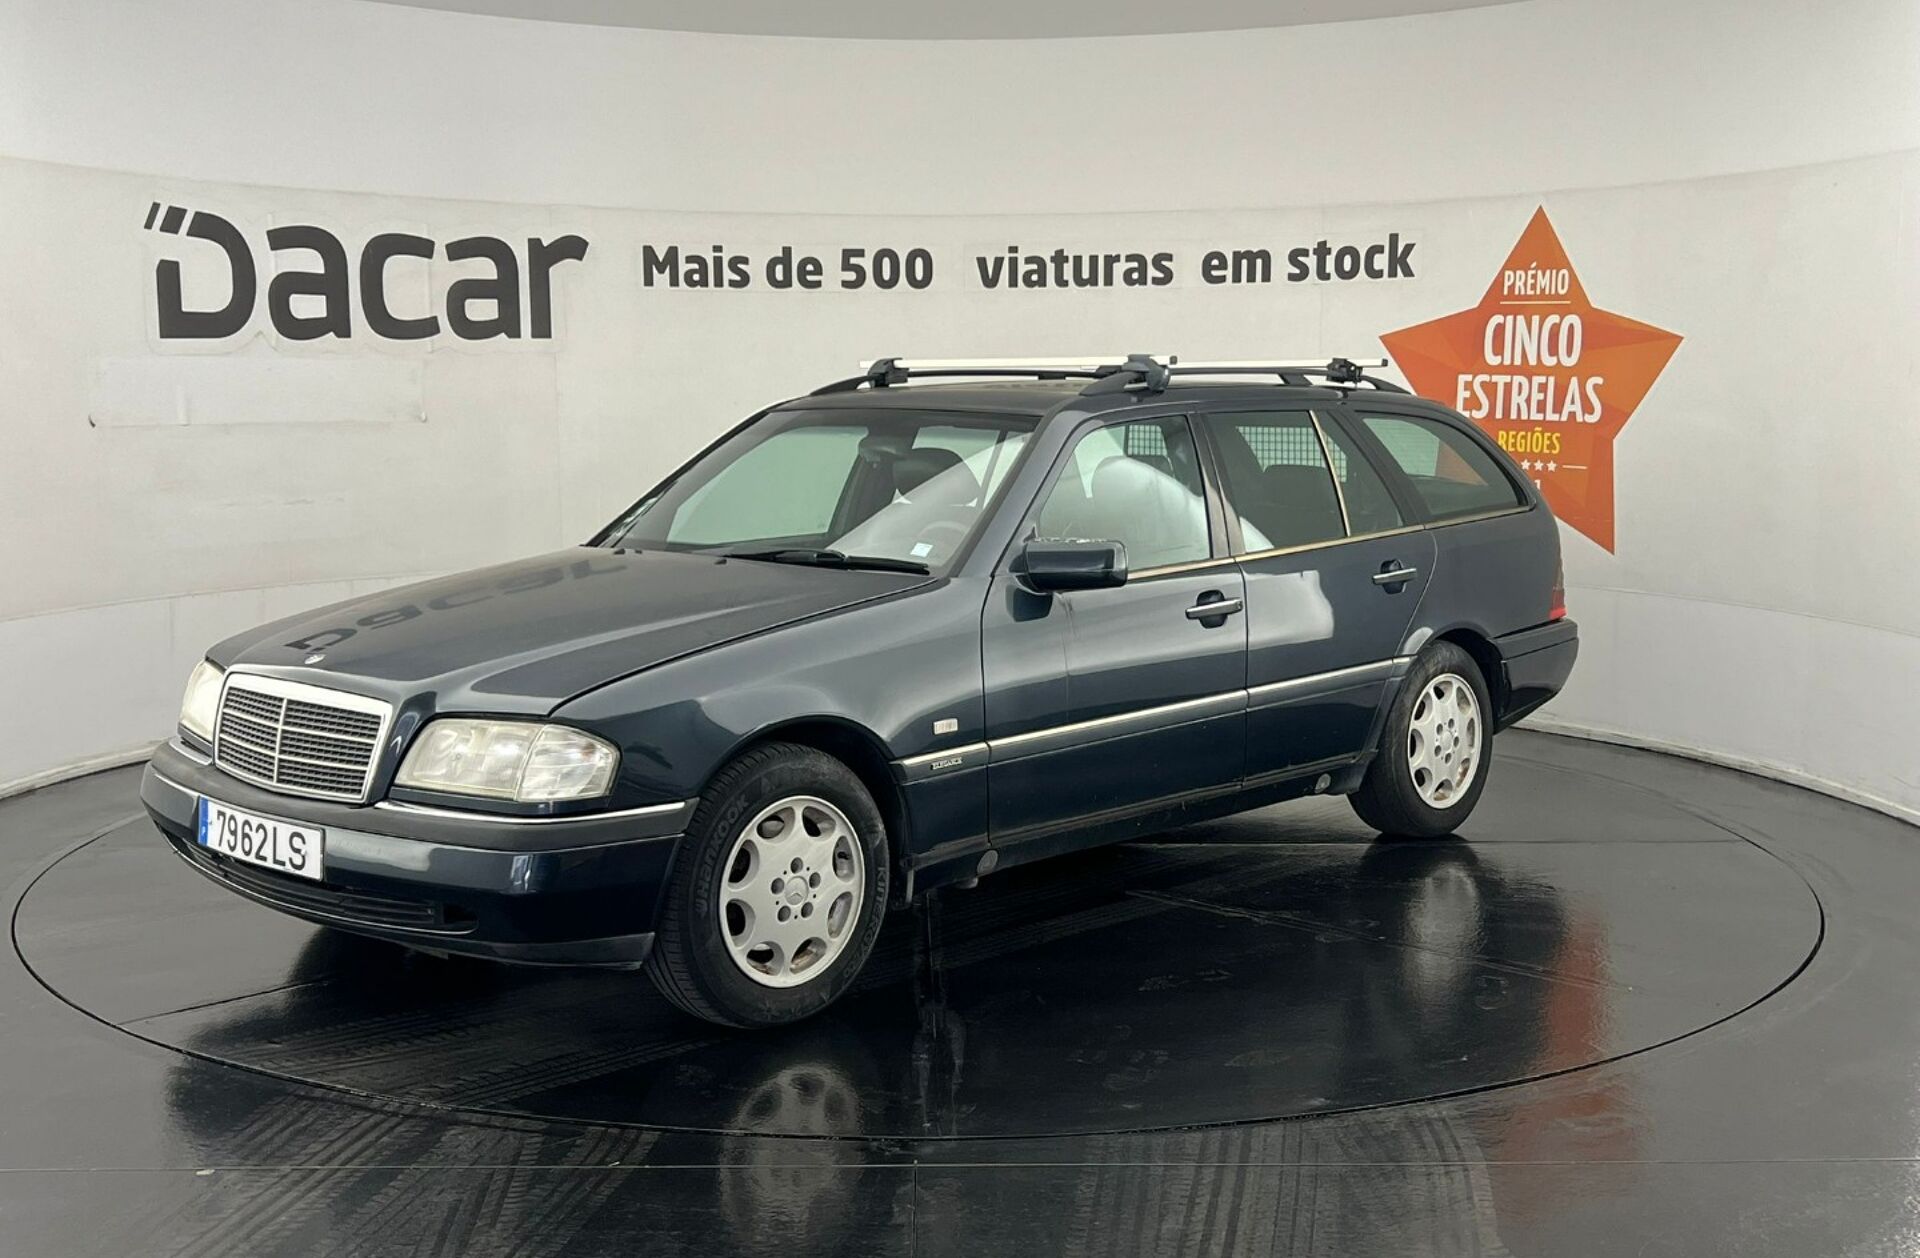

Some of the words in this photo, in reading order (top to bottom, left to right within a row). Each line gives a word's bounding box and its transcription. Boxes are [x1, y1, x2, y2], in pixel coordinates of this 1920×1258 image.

[144, 202, 589, 341] Dacar
[642, 245, 751, 289] Mais
[766, 246, 824, 290] de
[840, 248, 934, 290] 500
[976, 246, 1174, 289] viaturas
[1201, 250, 1272, 284] em
[1287, 233, 1417, 282] stock
[1503, 261, 1570, 296] PRÉMIO
[1483, 313, 1583, 367] CINCO
[1455, 373, 1604, 424] ESTRELAS
[1497, 426, 1561, 454] REGIÕES
[216, 809, 307, 871] 7962LS
